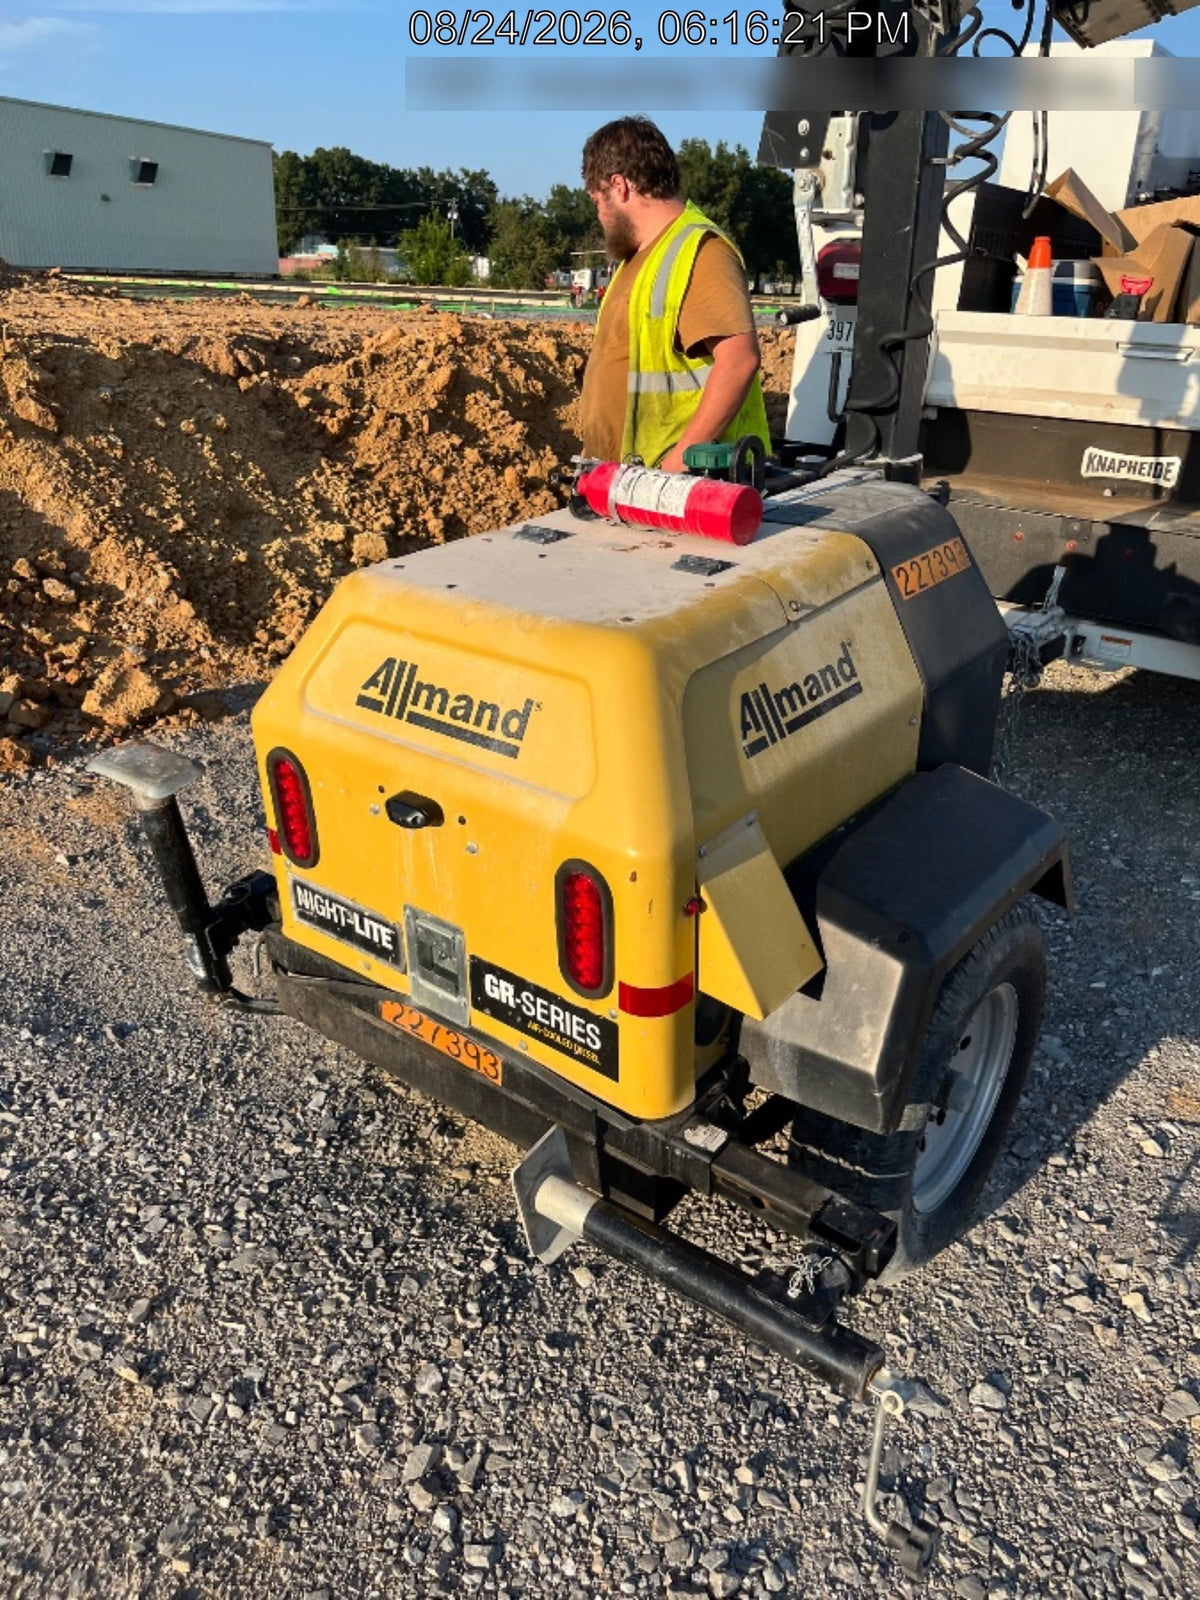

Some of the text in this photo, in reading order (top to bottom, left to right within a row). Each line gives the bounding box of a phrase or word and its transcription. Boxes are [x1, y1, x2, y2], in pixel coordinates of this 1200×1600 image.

[1085, 451, 1176, 482] KNAPHEIDE
[360, 656, 535, 742] Allmand
[741, 640, 858, 745] Allmand
[296, 884, 396, 951] NIGHT-LITE
[484, 973, 602, 1050] GR-SERIES
